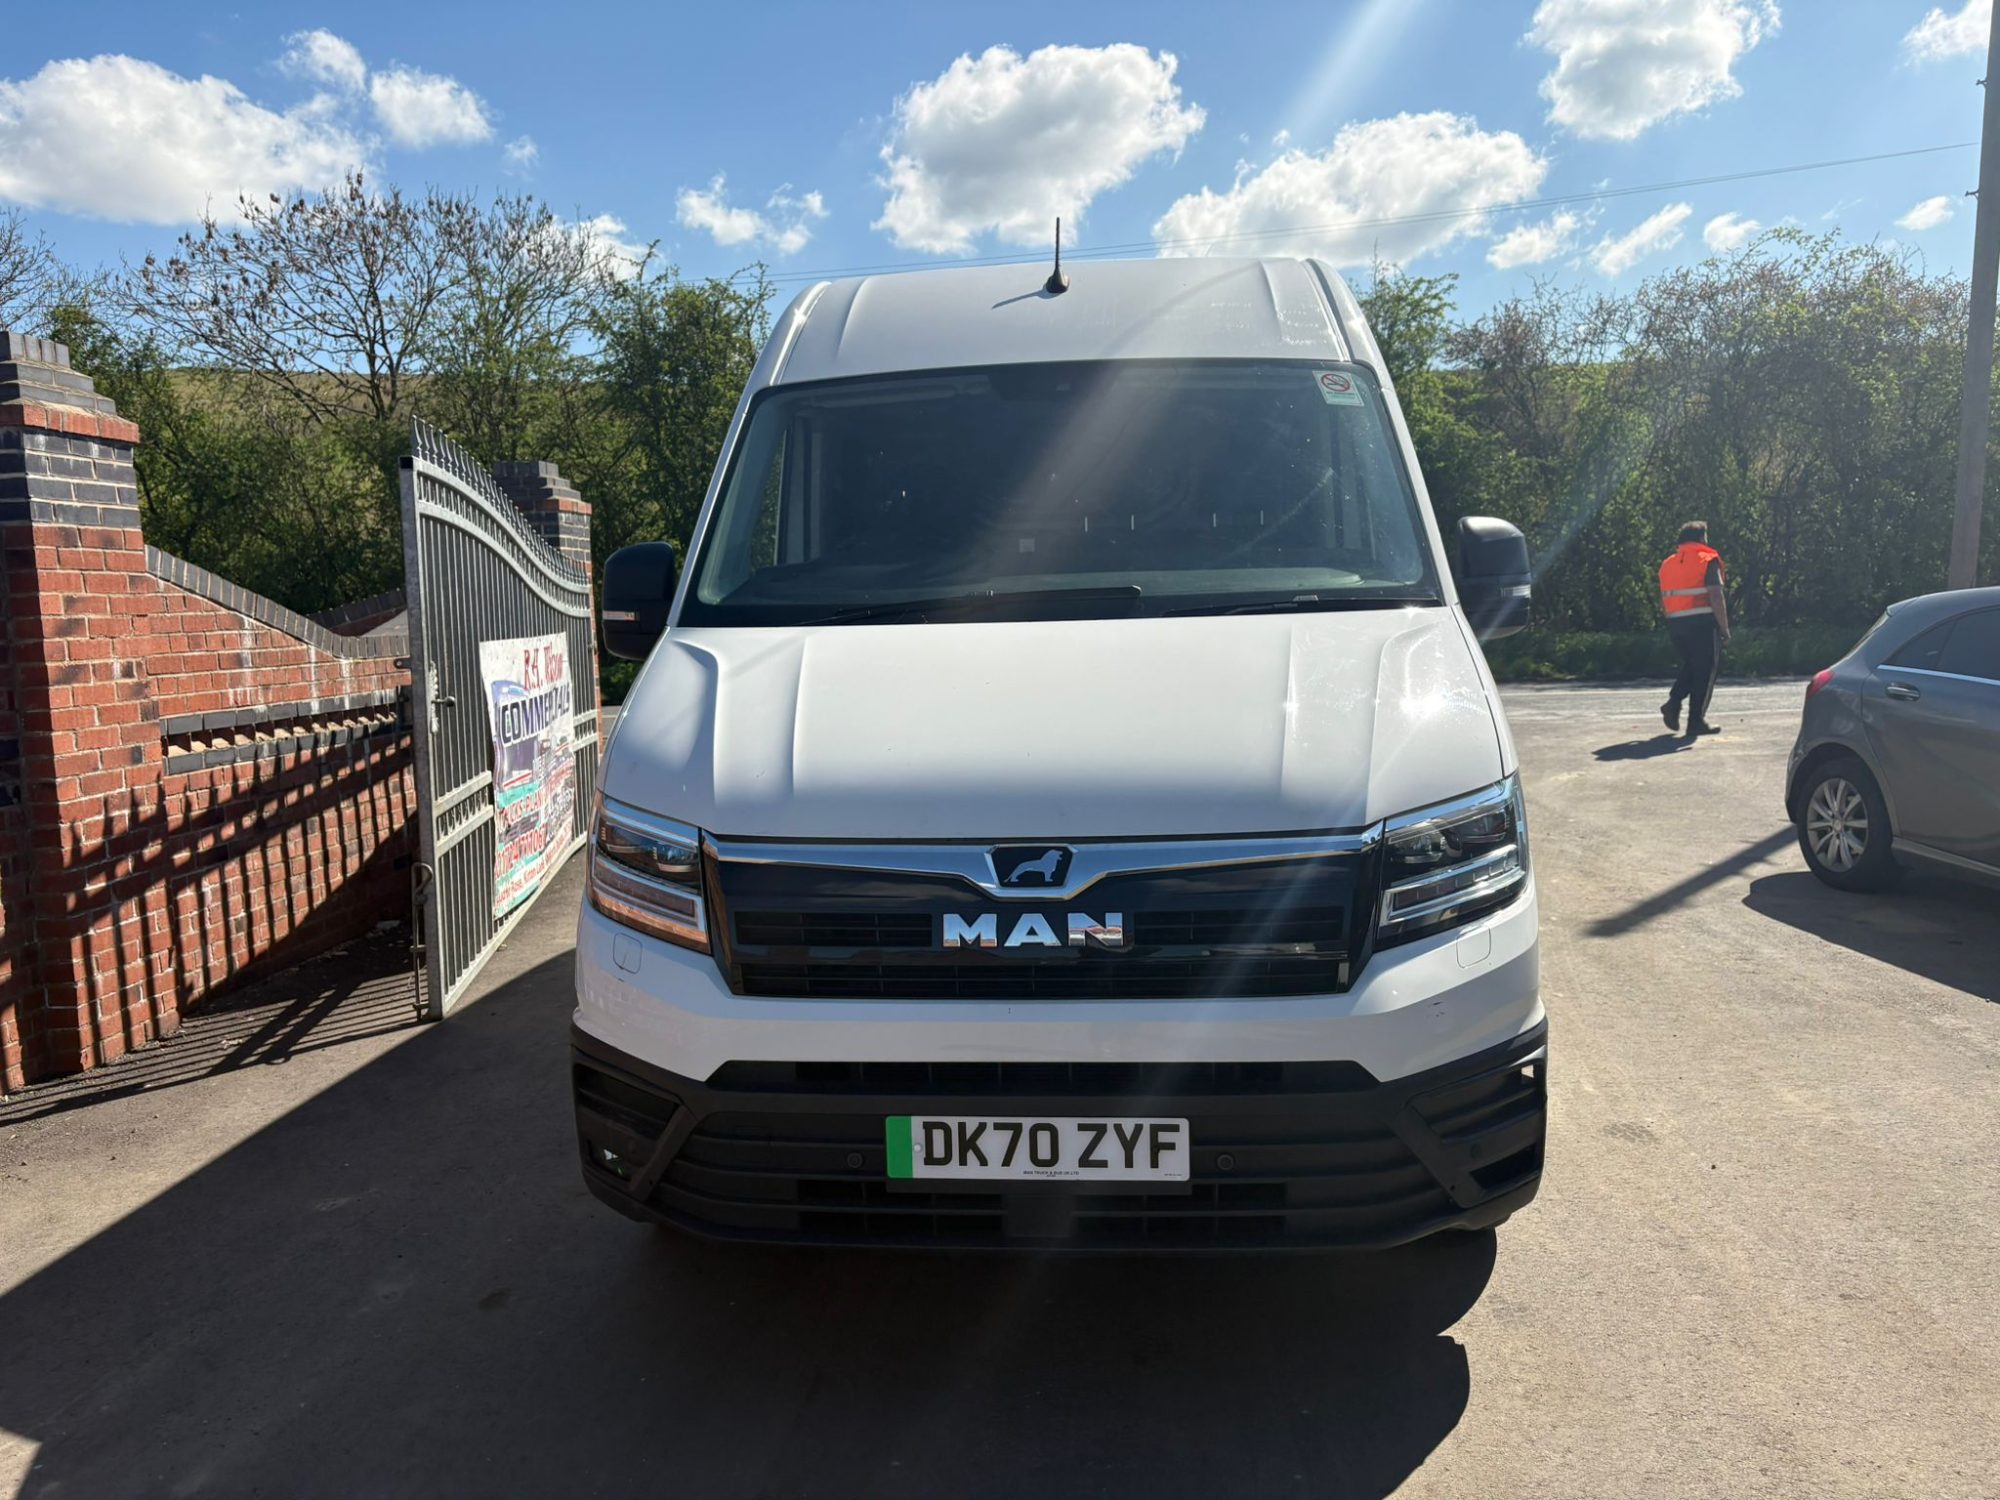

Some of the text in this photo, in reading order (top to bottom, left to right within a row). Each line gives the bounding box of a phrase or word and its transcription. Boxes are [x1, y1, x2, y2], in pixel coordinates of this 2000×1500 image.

[943, 912, 1123, 947] MAN
[922, 1121, 1181, 1169] DK70 ZYF
